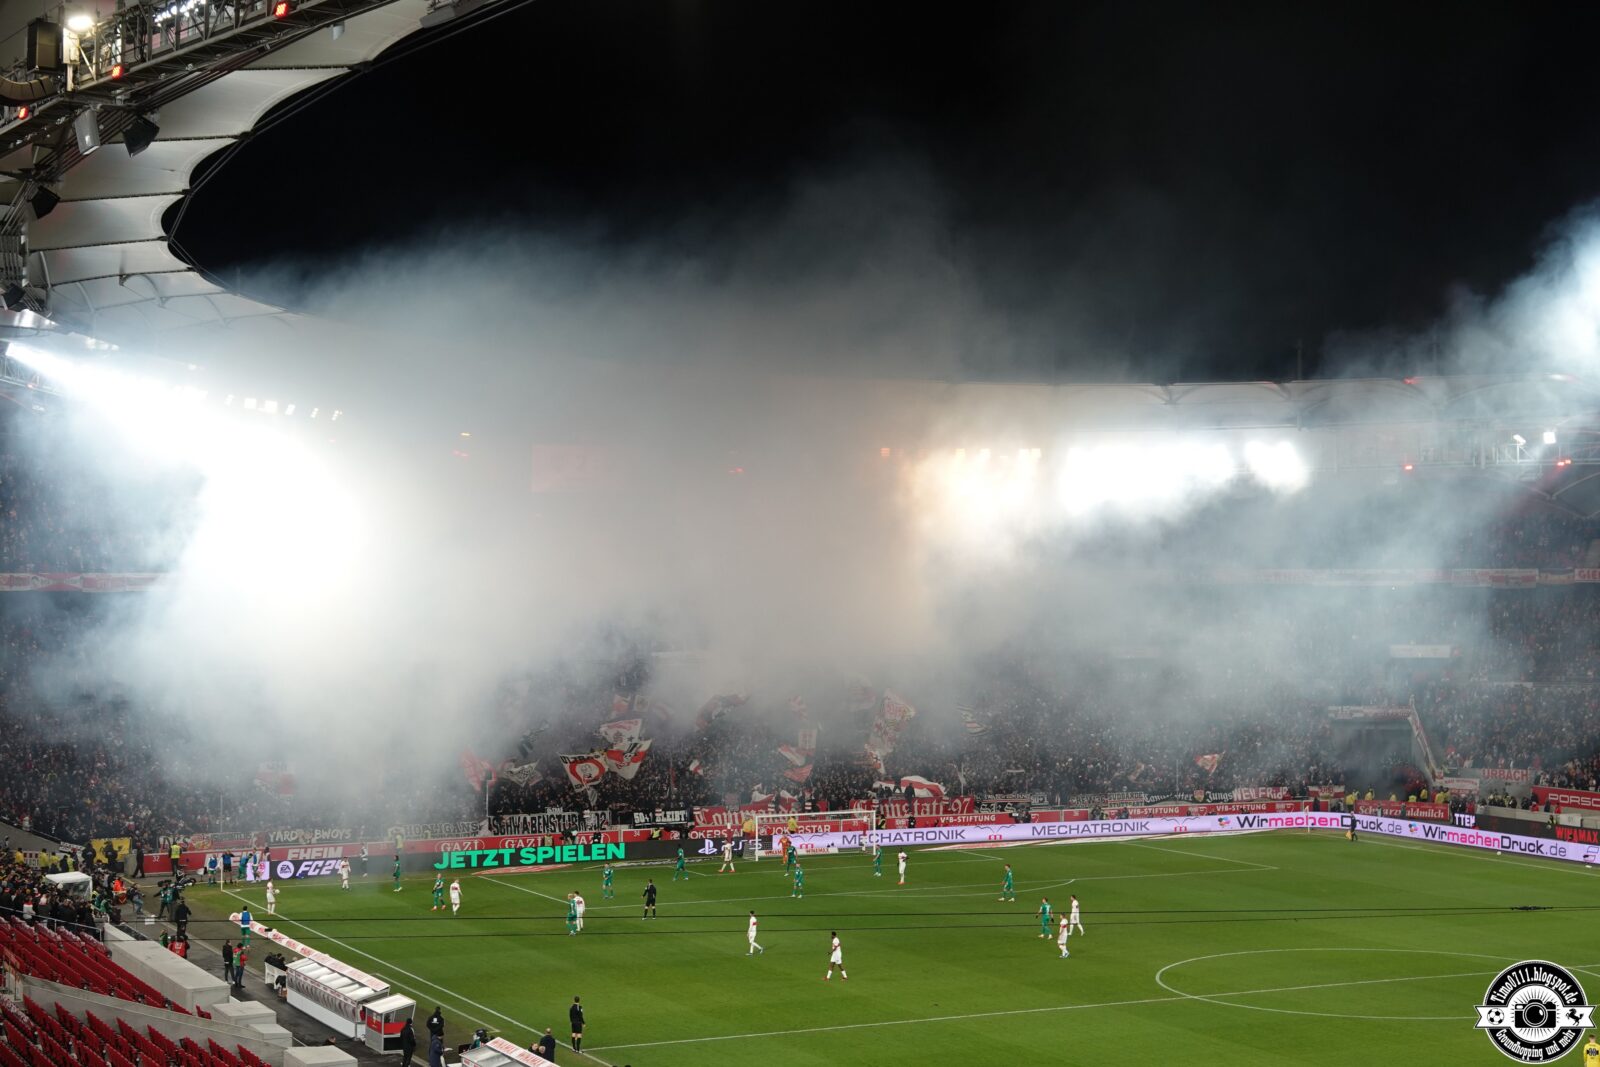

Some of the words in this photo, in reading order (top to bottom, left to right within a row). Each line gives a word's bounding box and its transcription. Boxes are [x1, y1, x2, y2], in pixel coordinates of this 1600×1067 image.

[1483, 769, 1528, 780] URBACH
[772, 825, 831, 835] JOKRSTAR
[1032, 820, 1151, 837] MECHATRONIK
[287, 846, 343, 860] EHEIM
[434, 848, 516, 870] JETZT
[519, 842, 626, 865] SPIELEN
